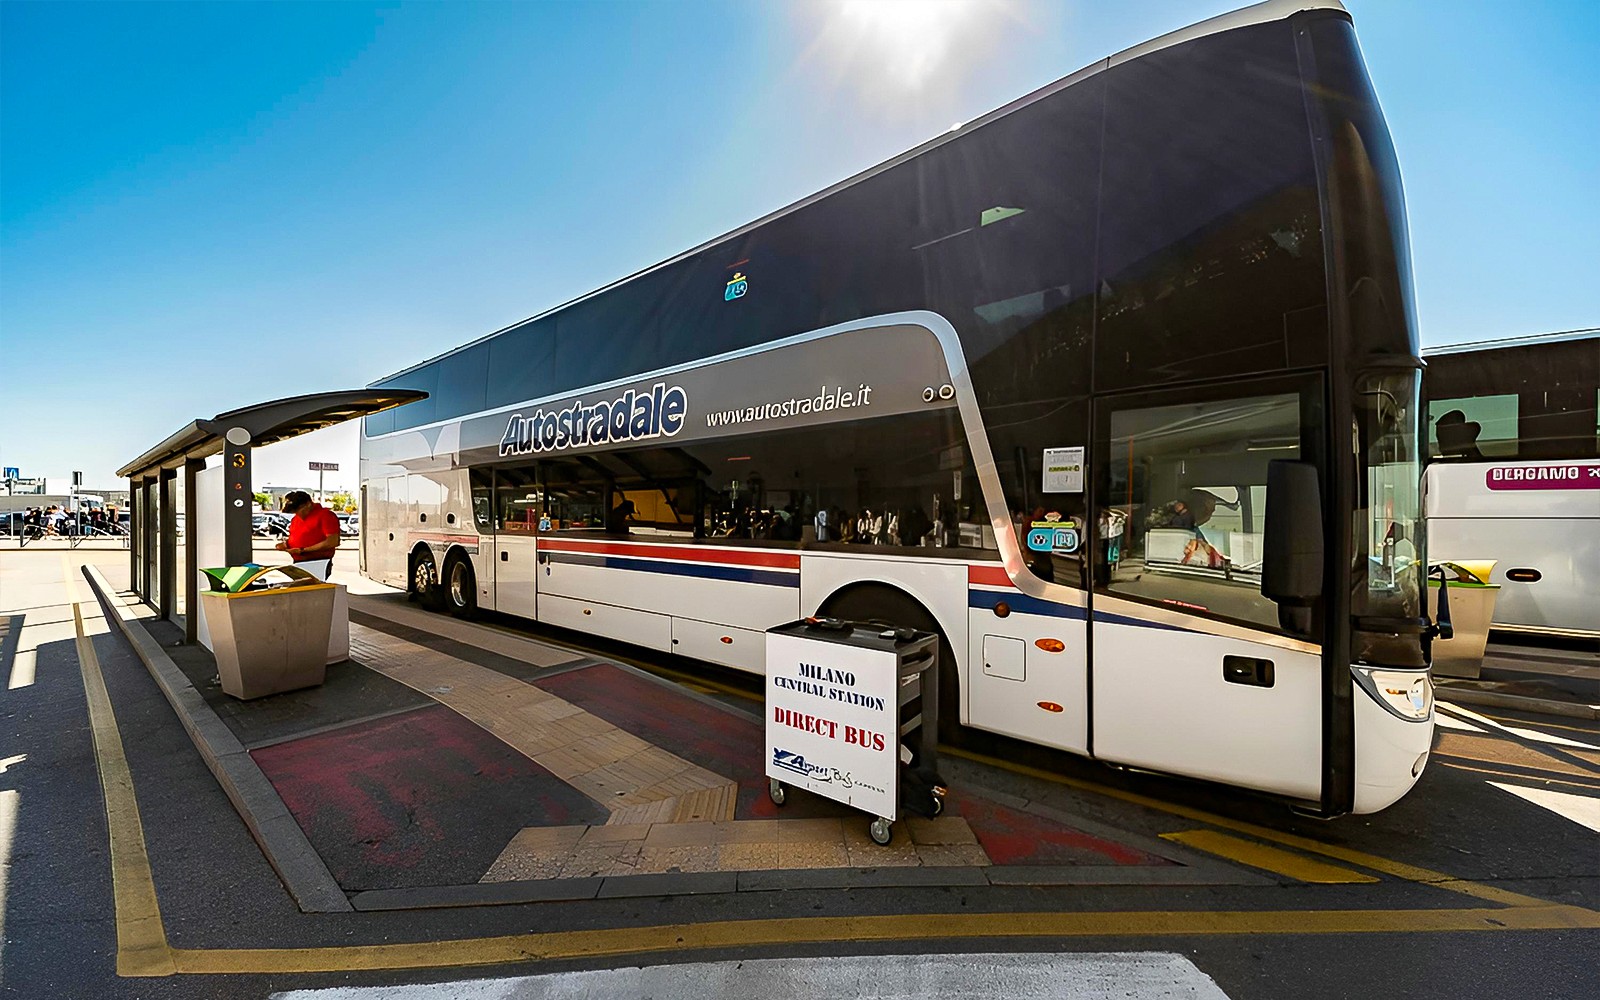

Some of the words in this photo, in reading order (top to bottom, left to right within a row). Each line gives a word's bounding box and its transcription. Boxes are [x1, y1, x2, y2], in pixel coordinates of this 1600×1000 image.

[500, 382, 687, 456] Autostradale
[706, 383, 872, 427] www.autostradale.it
[233, 453, 245, 468] 3
[1492, 467, 1579, 481] BERGAMO
[798, 662, 856, 687] MILANO
[774, 676, 827, 698] CENTRAL
[829, 687, 885, 712] STATION
[774, 706, 838, 739] DIRECT
[844, 725, 885, 752] BUS
